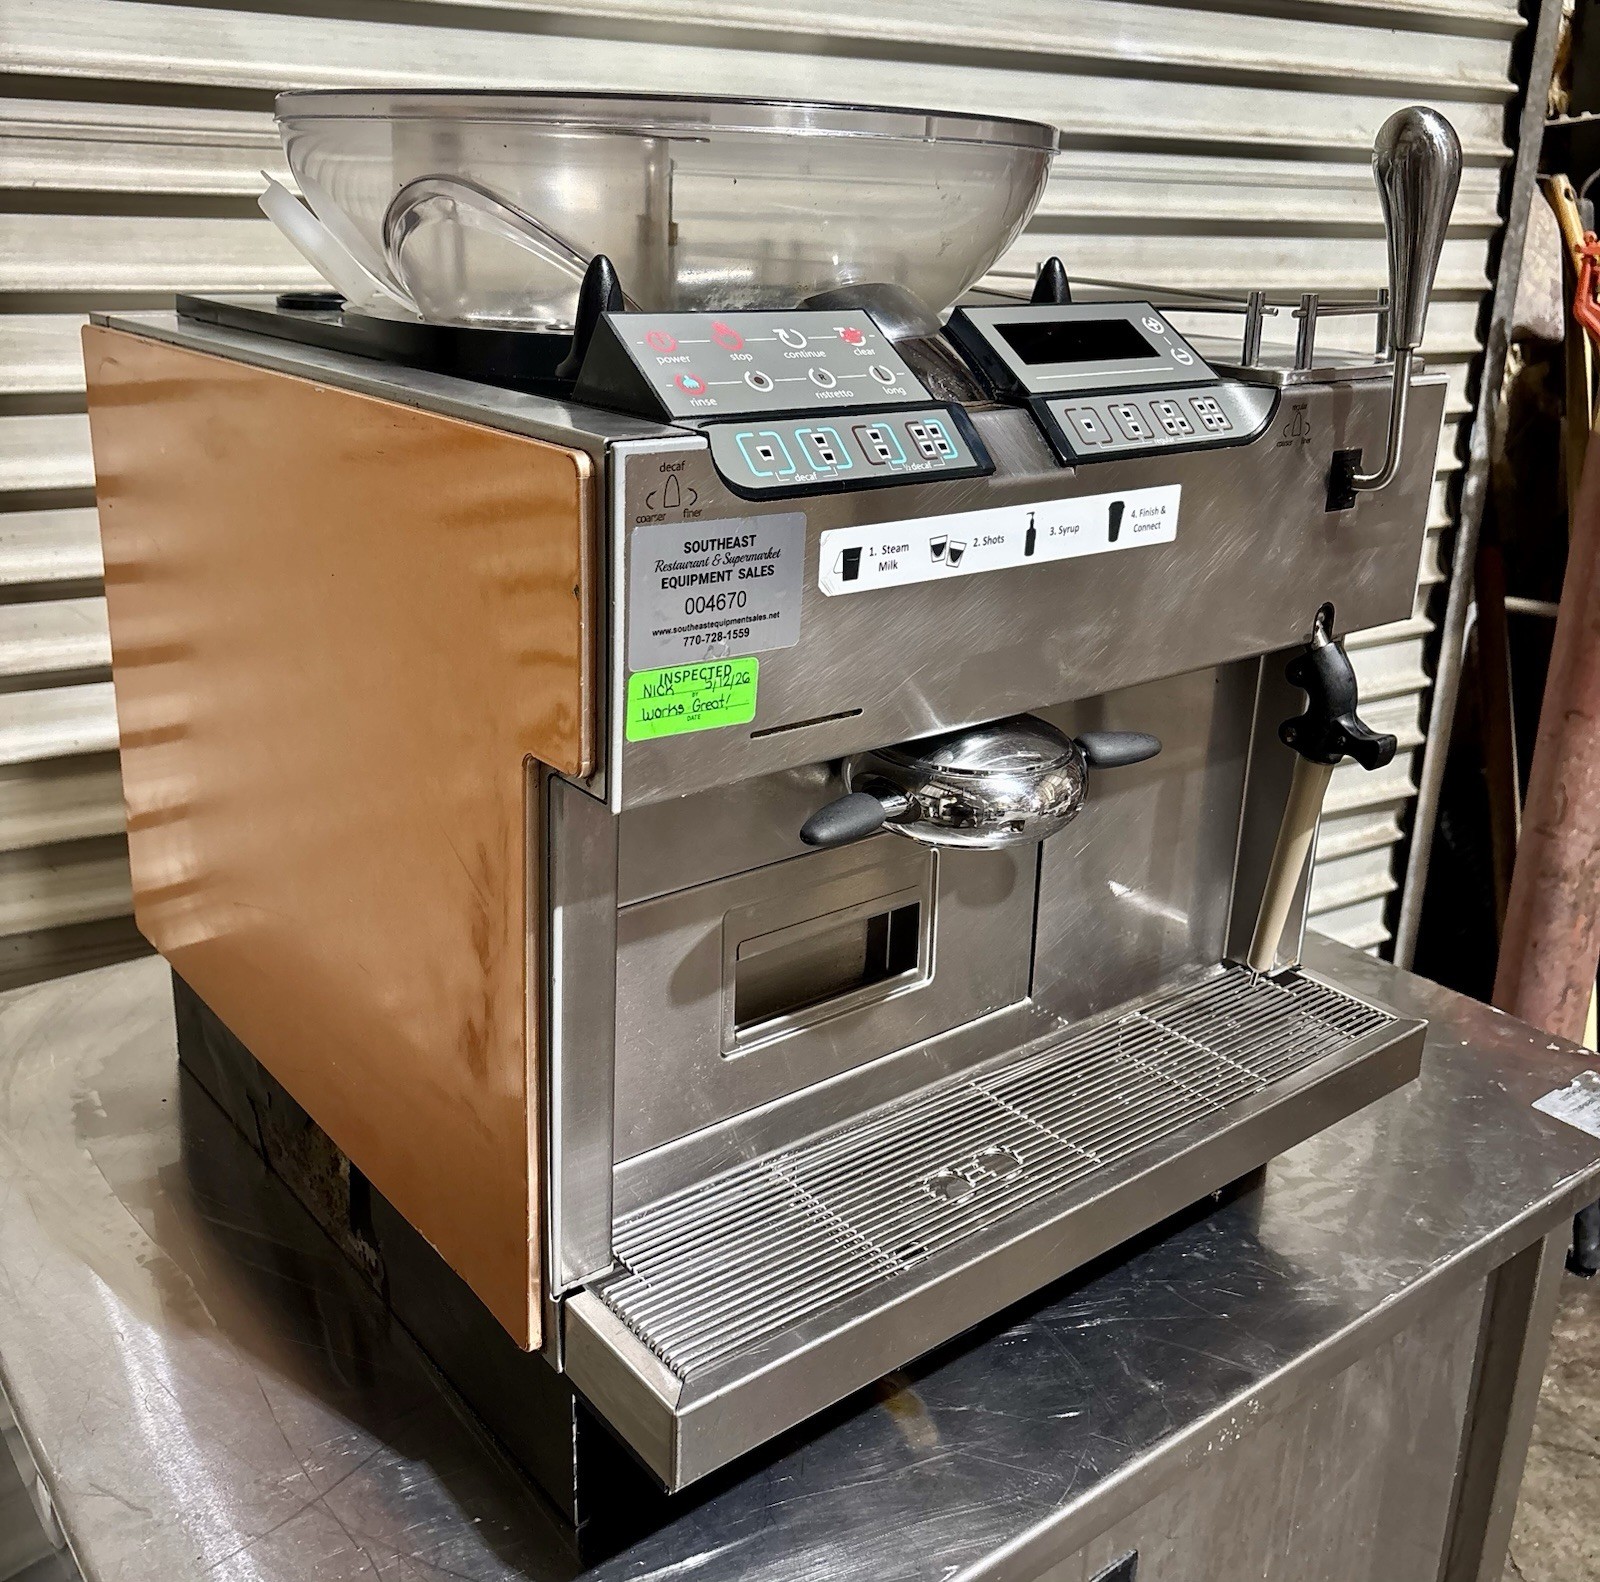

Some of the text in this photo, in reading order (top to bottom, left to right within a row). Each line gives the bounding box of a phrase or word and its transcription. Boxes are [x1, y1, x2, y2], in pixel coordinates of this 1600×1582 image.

[656, 348, 876, 365] power stop continue clear
[690, 386, 907, 407] rinse ristretto long
[659, 460, 686, 473] decaf
[794, 471, 818, 482] decaf
[683, 508, 703, 518] finer
[1131, 505, 1166, 518] 4. Finish &
[1049, 524, 1080, 536] 3. Syrup
[1133, 520, 1161, 533] Connect
[683, 534, 757, 554] SOUTHEAST
[973, 534, 1005, 548] 2. Shots
[869, 543, 910, 557] 1. Steam
[654, 546, 782, 573] Restaurant & Supermarket
[878, 559, 898, 572] Milk
[661, 564, 775, 589] EQUIPMENT SALES
[684, 590, 748, 615] 004670
[651, 611, 780, 636] www.southeastequipmentsales.net
[683, 627, 750, 647] 770-728-1559
[659, 664, 732, 686] INSPECTED
[643, 671, 751, 699] NICK 5/12/26
[692, 693, 731, 713] Great!
[686, 713, 702, 722] DATE
